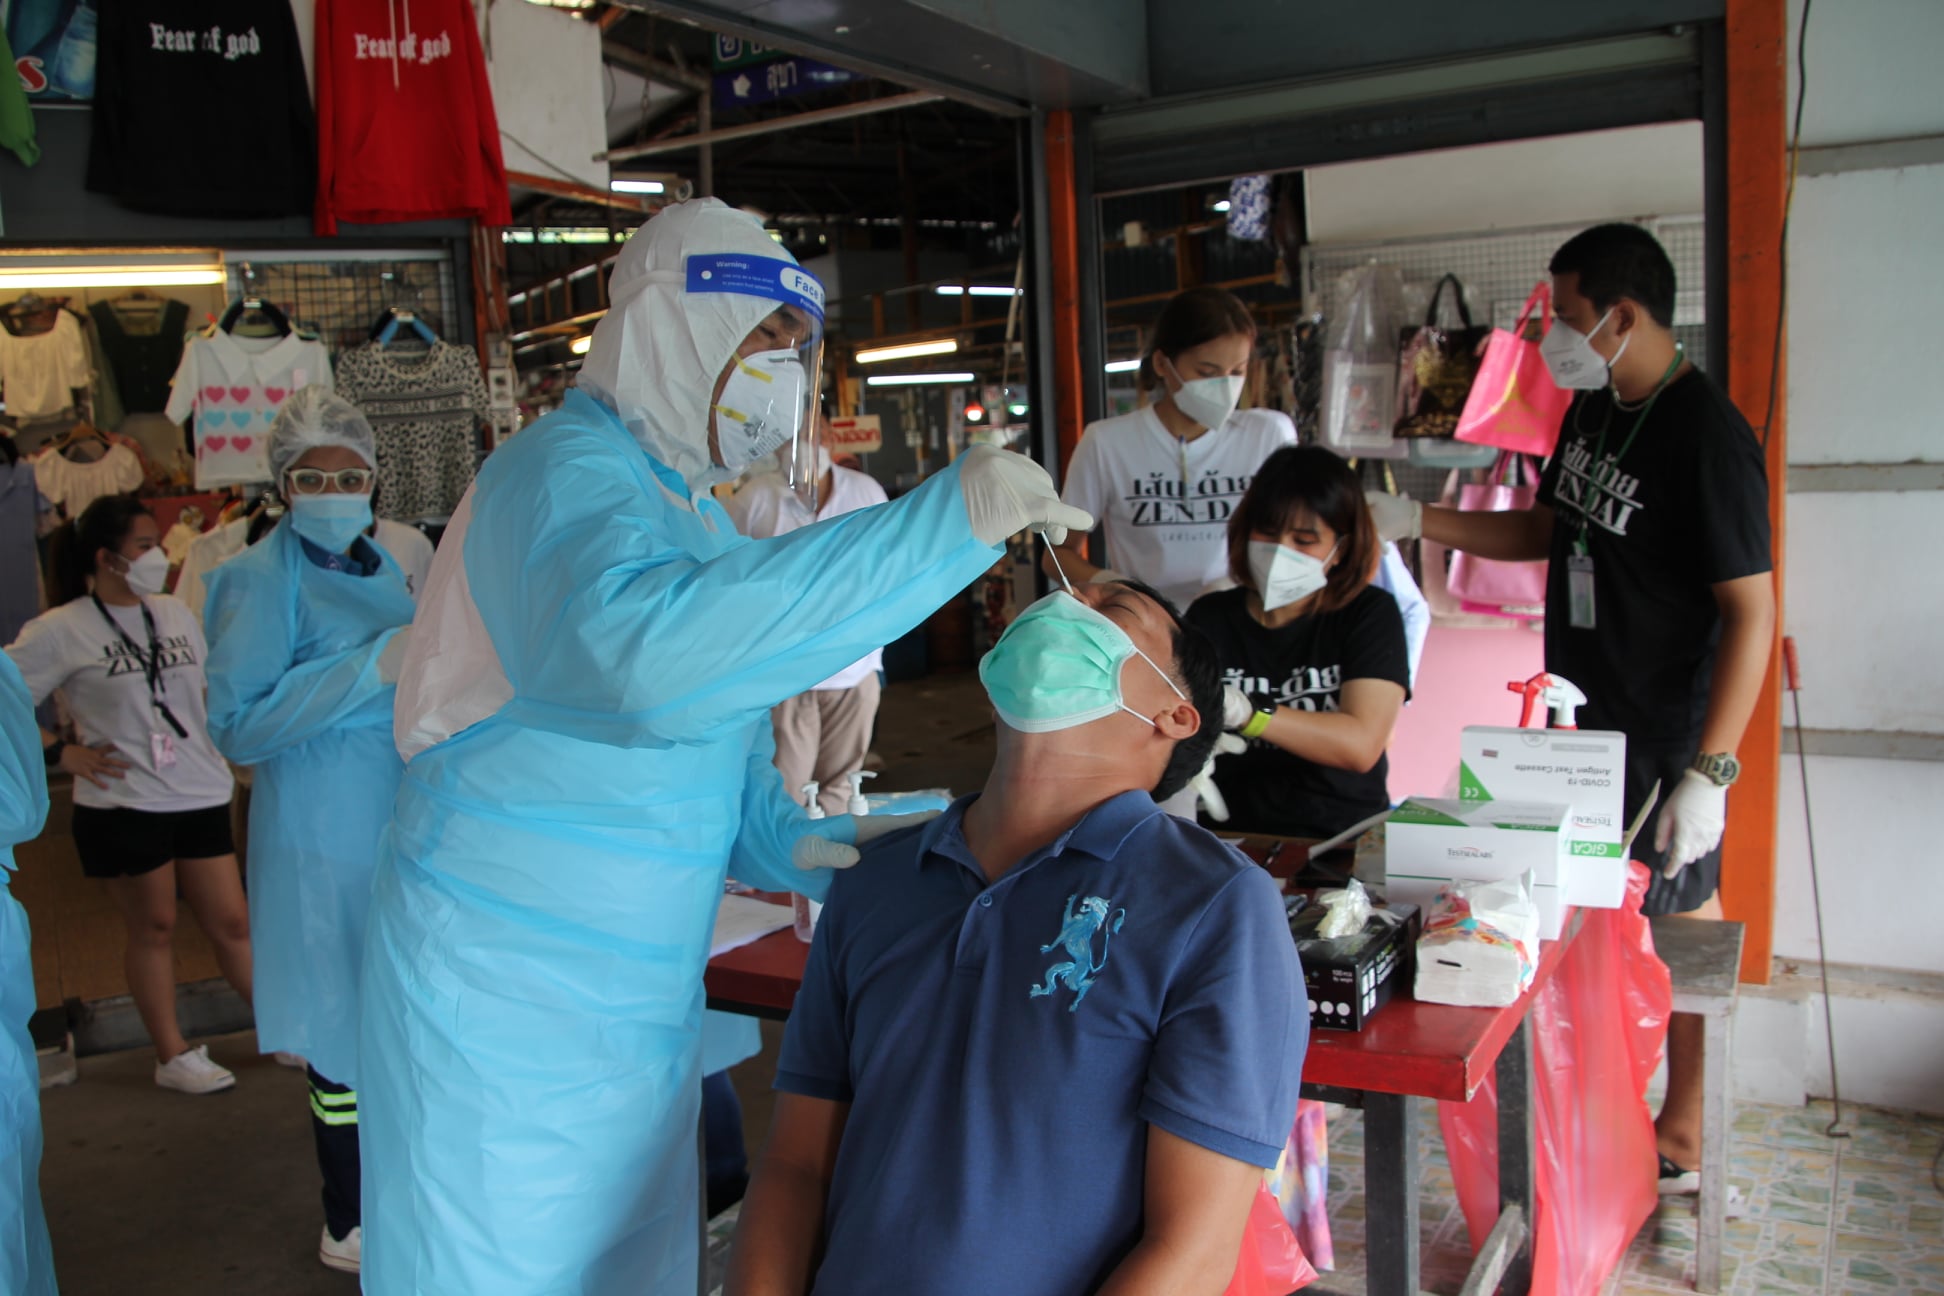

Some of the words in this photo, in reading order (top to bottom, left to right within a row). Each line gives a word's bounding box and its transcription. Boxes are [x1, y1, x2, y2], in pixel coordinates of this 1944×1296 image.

[149, 22, 196, 51] Fear
[224, 26, 260, 60] god
[354, 33, 396, 59] Fear
[419, 30, 451, 65] god
[794, 274, 819, 300] Face
[1128, 500, 1230, 526] ZEN-D
[1514, 763, 1554, 774] Cassette
[1554, 765, 1574, 775] Test
[1576, 766, 1612, 776] Antigen
[1567, 778, 1612, 787] COVID-19
[1574, 842, 1607, 856] GICA
